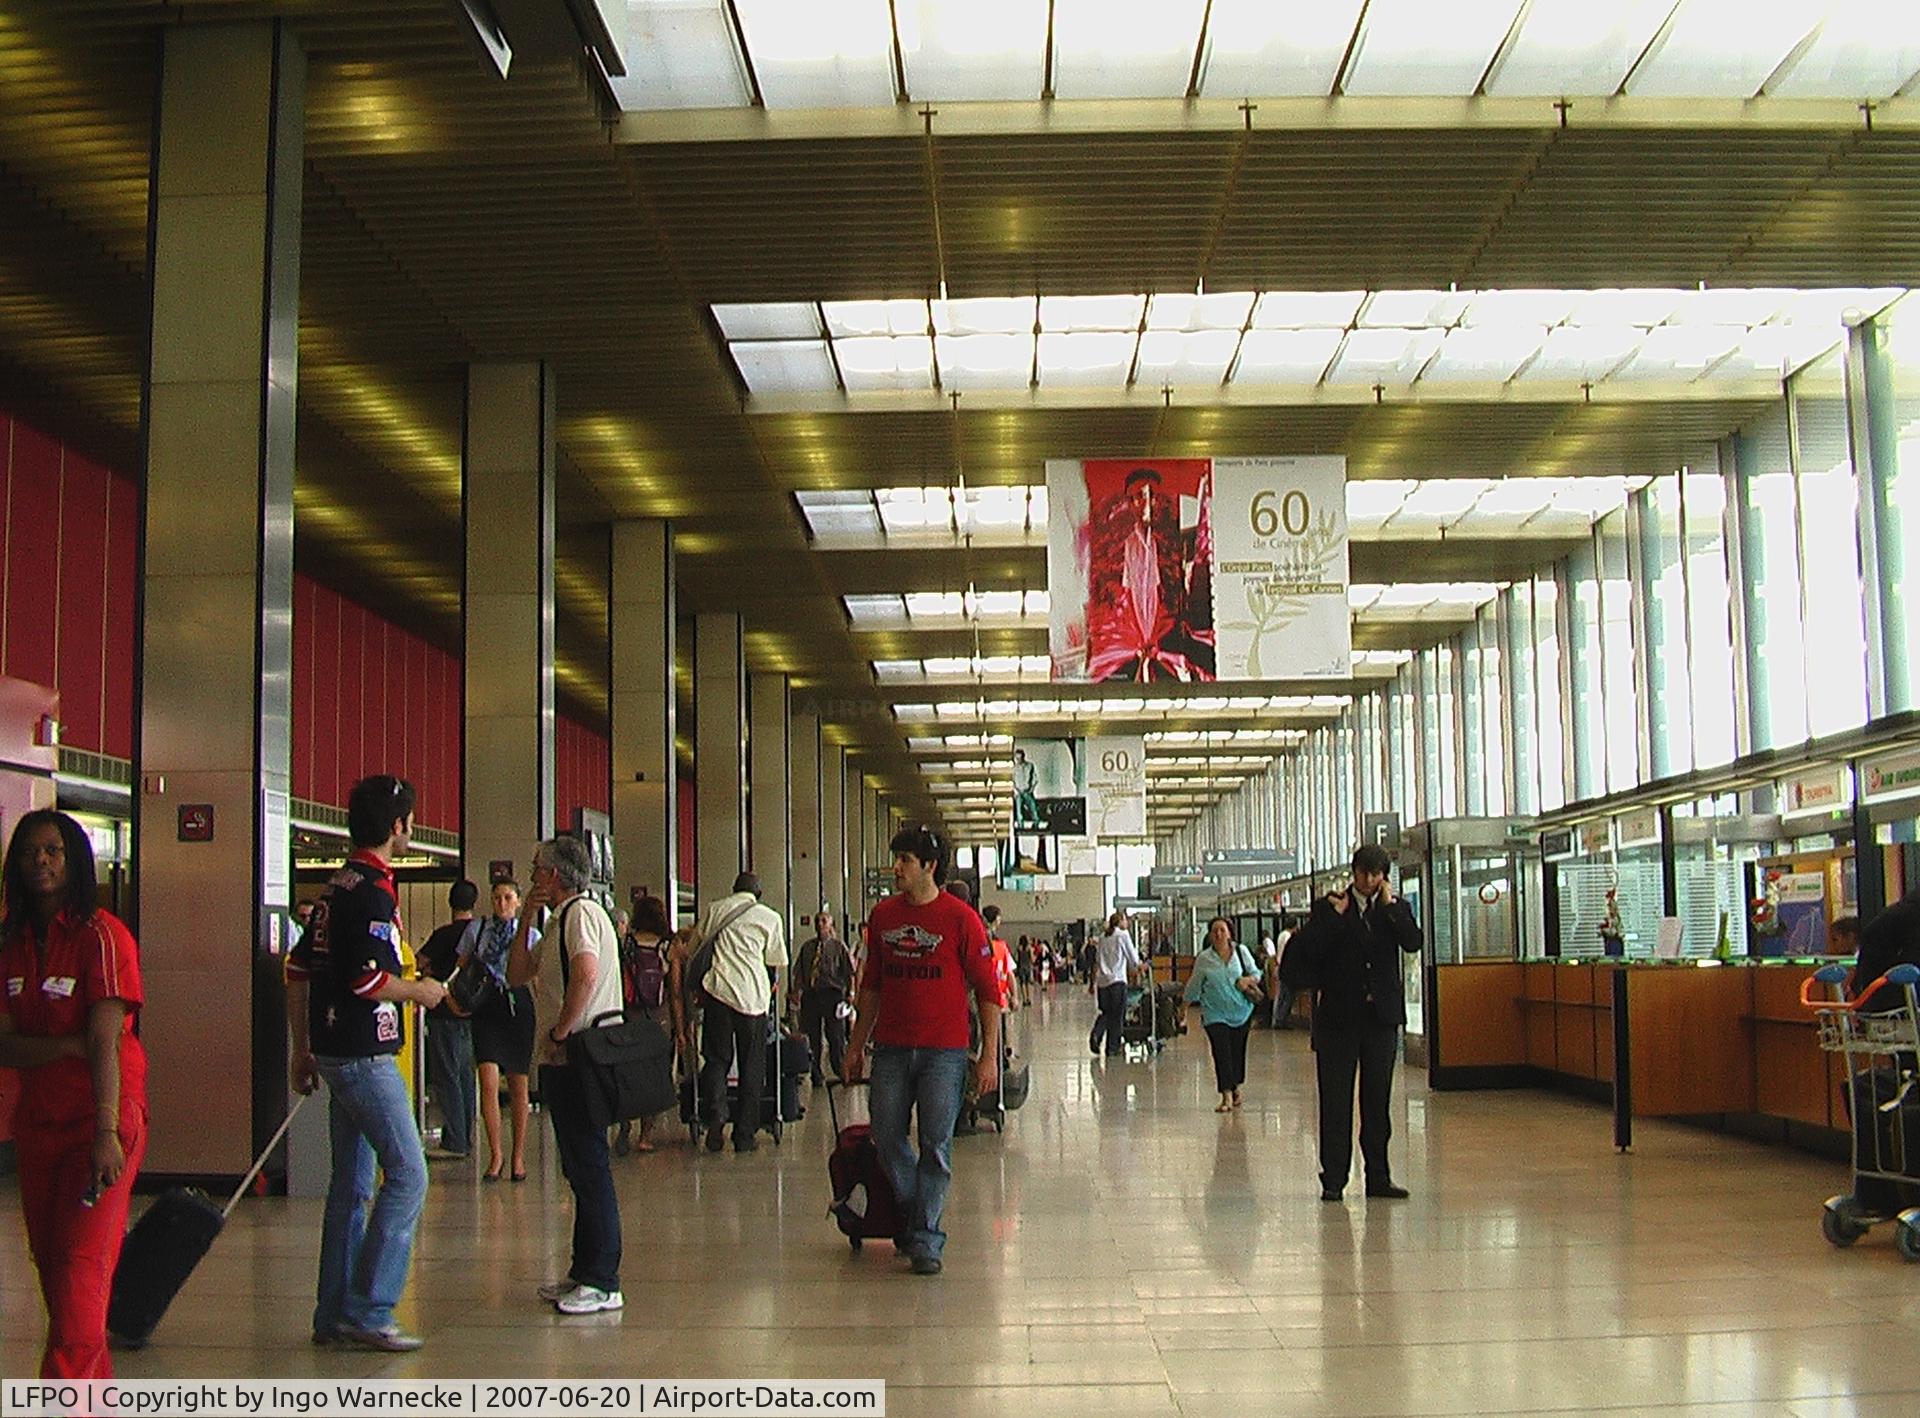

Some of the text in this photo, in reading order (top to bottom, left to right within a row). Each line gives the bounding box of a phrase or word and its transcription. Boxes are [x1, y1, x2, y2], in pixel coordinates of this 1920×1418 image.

[1250, 490, 1310, 537] 60
[1102, 751, 1128, 772] 60
[1377, 824, 1388, 846] F
